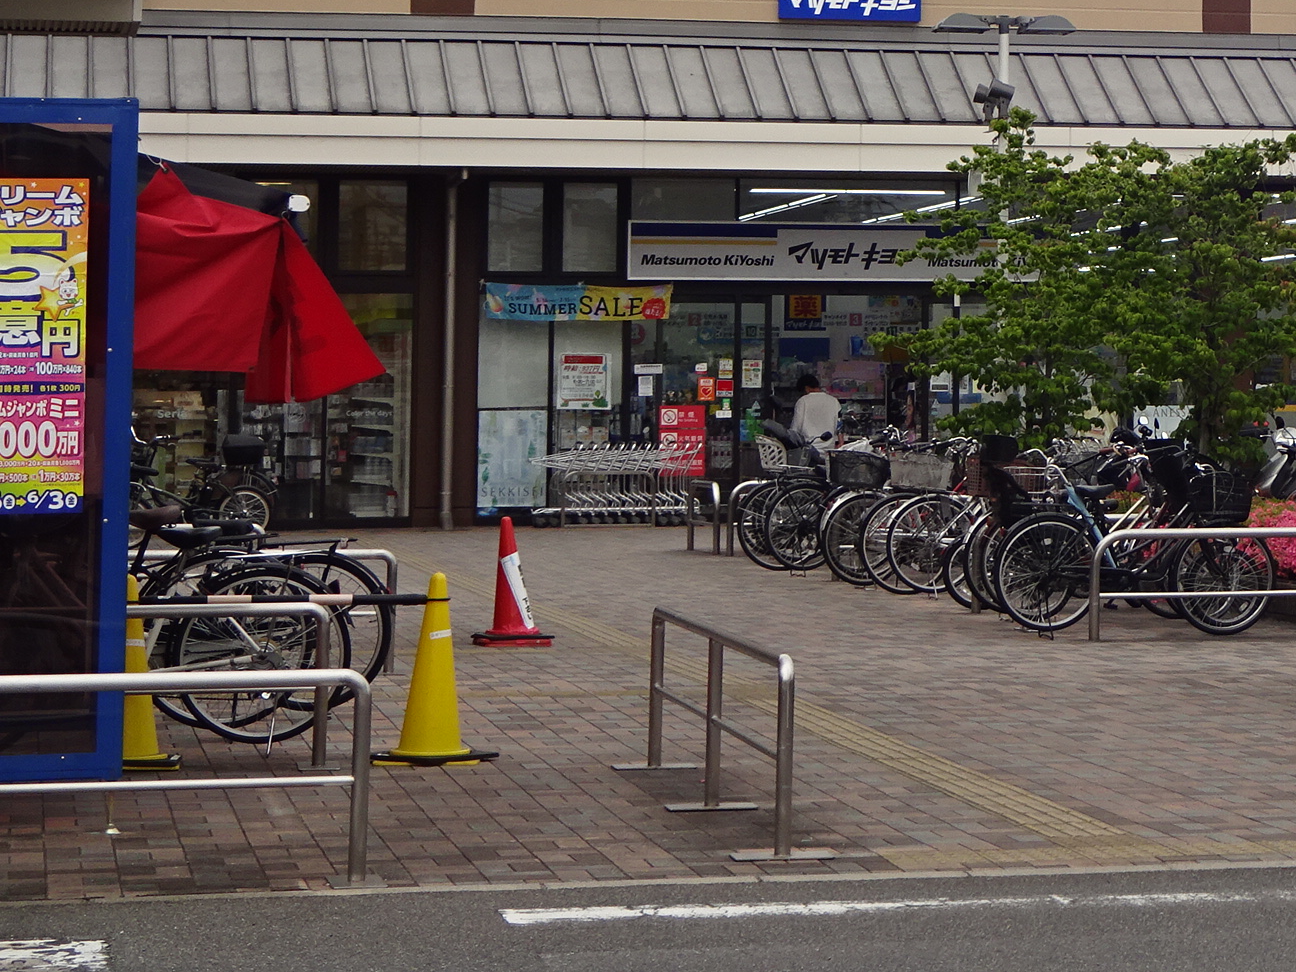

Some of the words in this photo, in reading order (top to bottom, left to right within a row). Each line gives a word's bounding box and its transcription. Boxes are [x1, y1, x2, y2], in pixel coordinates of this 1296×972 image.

[641, 254, 722, 266] Matsumoto
[723, 254, 775, 266] KiYoshi
[927, 257, 999, 268] Matsumot
[508, 302, 577, 315] SUMMER
[579, 295, 643, 317] SALE
[481, 487, 544, 497] SEKKISEI
